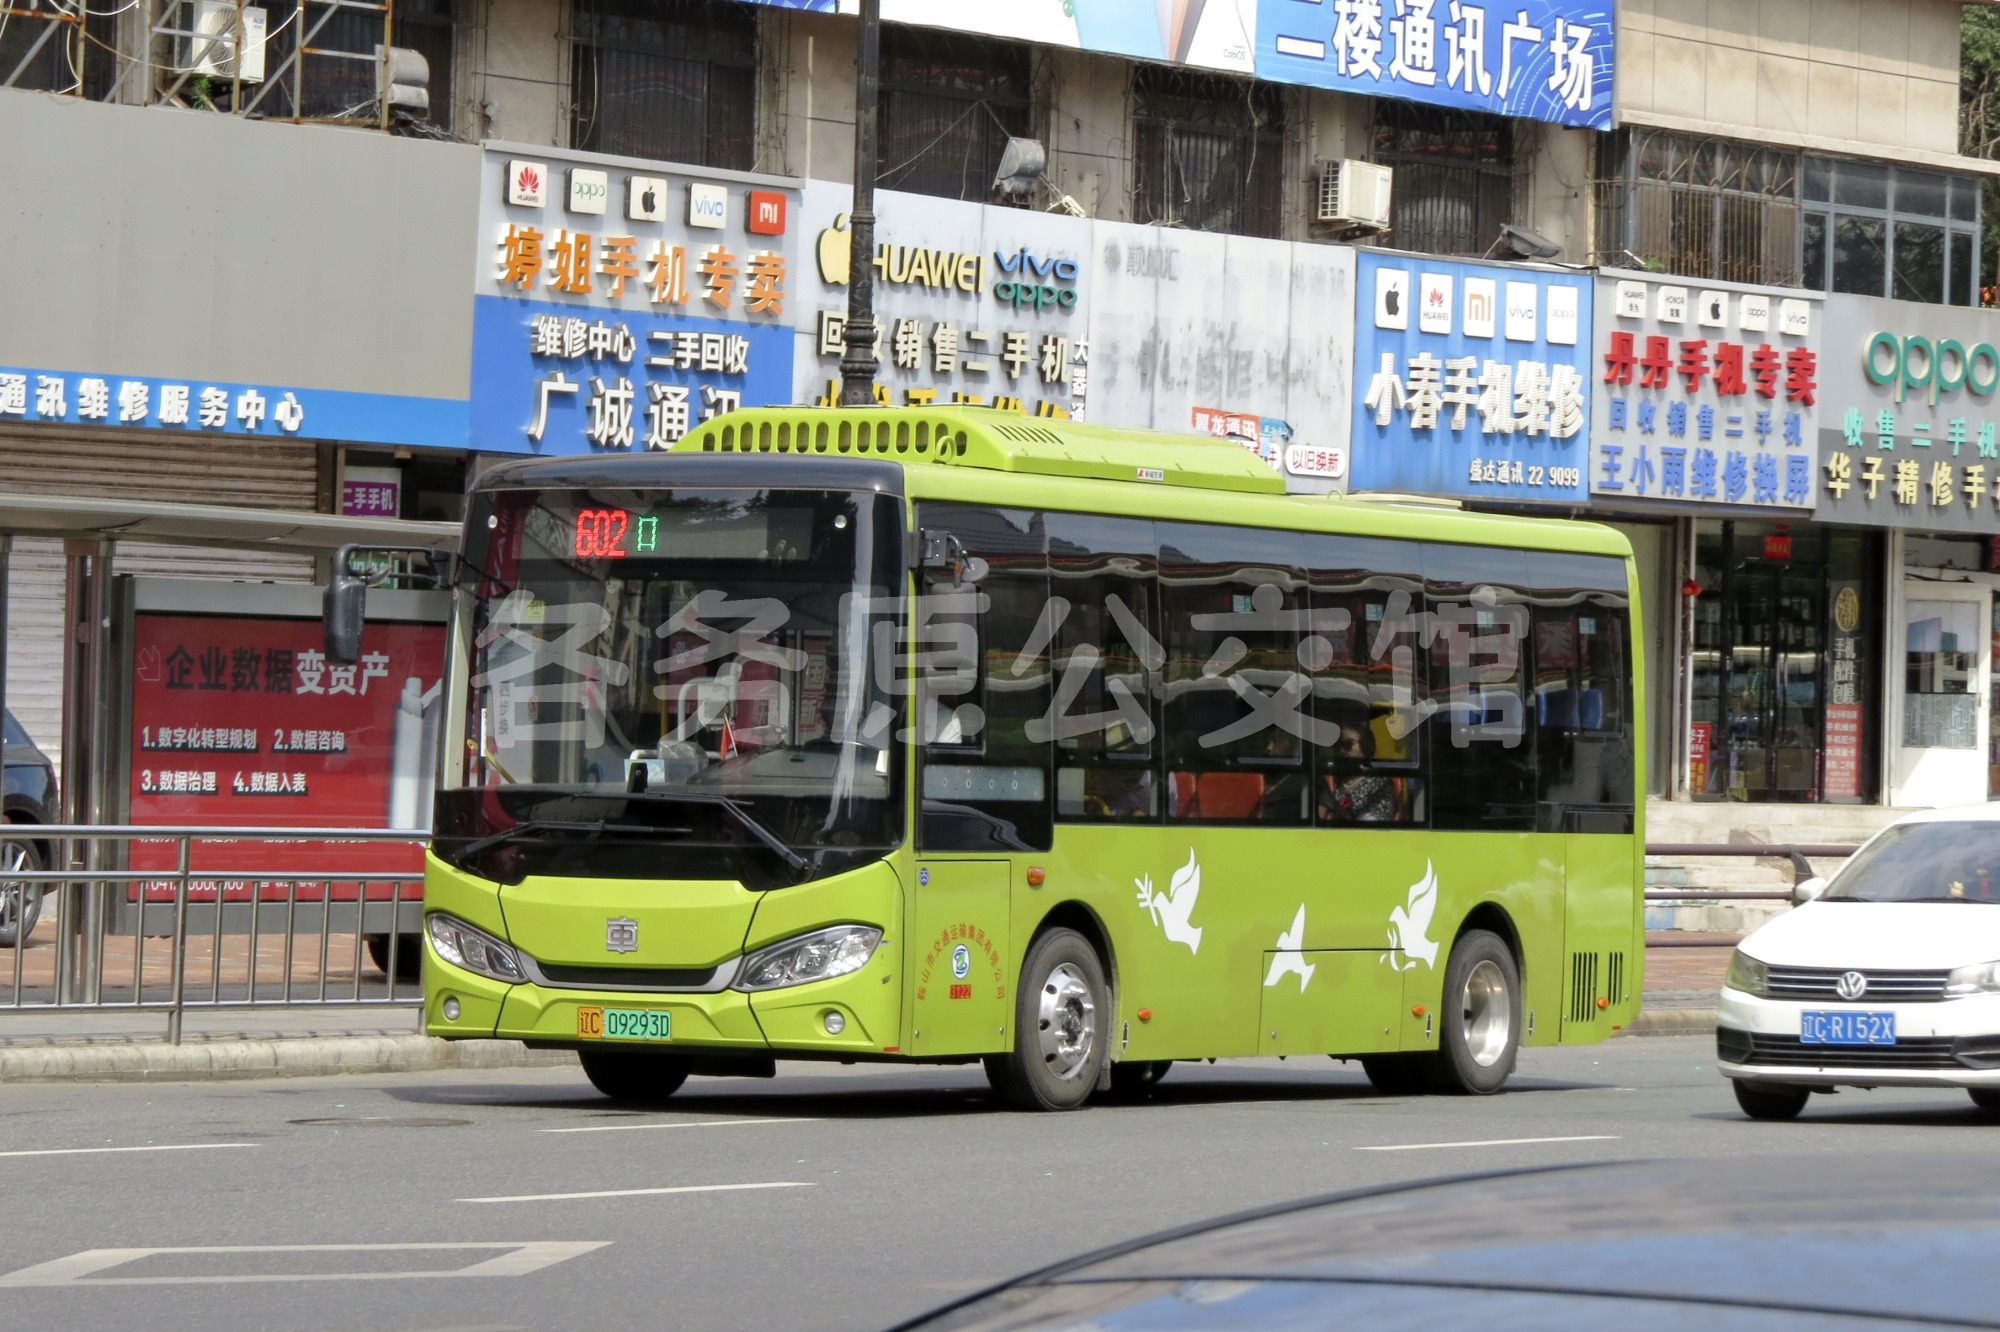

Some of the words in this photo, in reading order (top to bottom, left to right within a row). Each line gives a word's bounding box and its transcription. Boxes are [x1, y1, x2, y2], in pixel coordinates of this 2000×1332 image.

[496, 222, 786, 317] 婷姐手机专卖
[872, 242, 986, 294] HUAWEI
[993, 246, 1080, 281] vivo
[995, 280, 1079, 310] oppo
[530, 314, 637, 362] 维修中心
[644, 330, 750, 374] 二手回收
[1604, 331, 1818, 406] 丹丹手机专卖
[0, 373, 304, 432] 通讯维修服务中心
[1364, 352, 1585, 439] 小春手机维修
[1608, 397, 1803, 446] 回收销售二手机
[1843, 407, 1998, 459] 收售二手机
[1292, 449, 1339, 473] 以旧换新
[1469, 458, 1524, 484] 盛达通讯
[1528, 466, 1544, 485] 22
[1549, 467, 1579, 487] 9099
[1822, 451, 2000, 511] 华子精修手
[343, 487, 394, 511] 二手手机
[575, 509, 629, 557] 602
[165, 645, 390, 696] 企业数据变资产
[142, 726, 257, 750] 1.数字化转型规划
[273, 729, 345, 751] 2.数据咨询
[140, 770, 217, 792] 3.数据治理
[233, 770, 307, 793] 4.数据入表
[608, 1012, 669, 1037] 09293D
